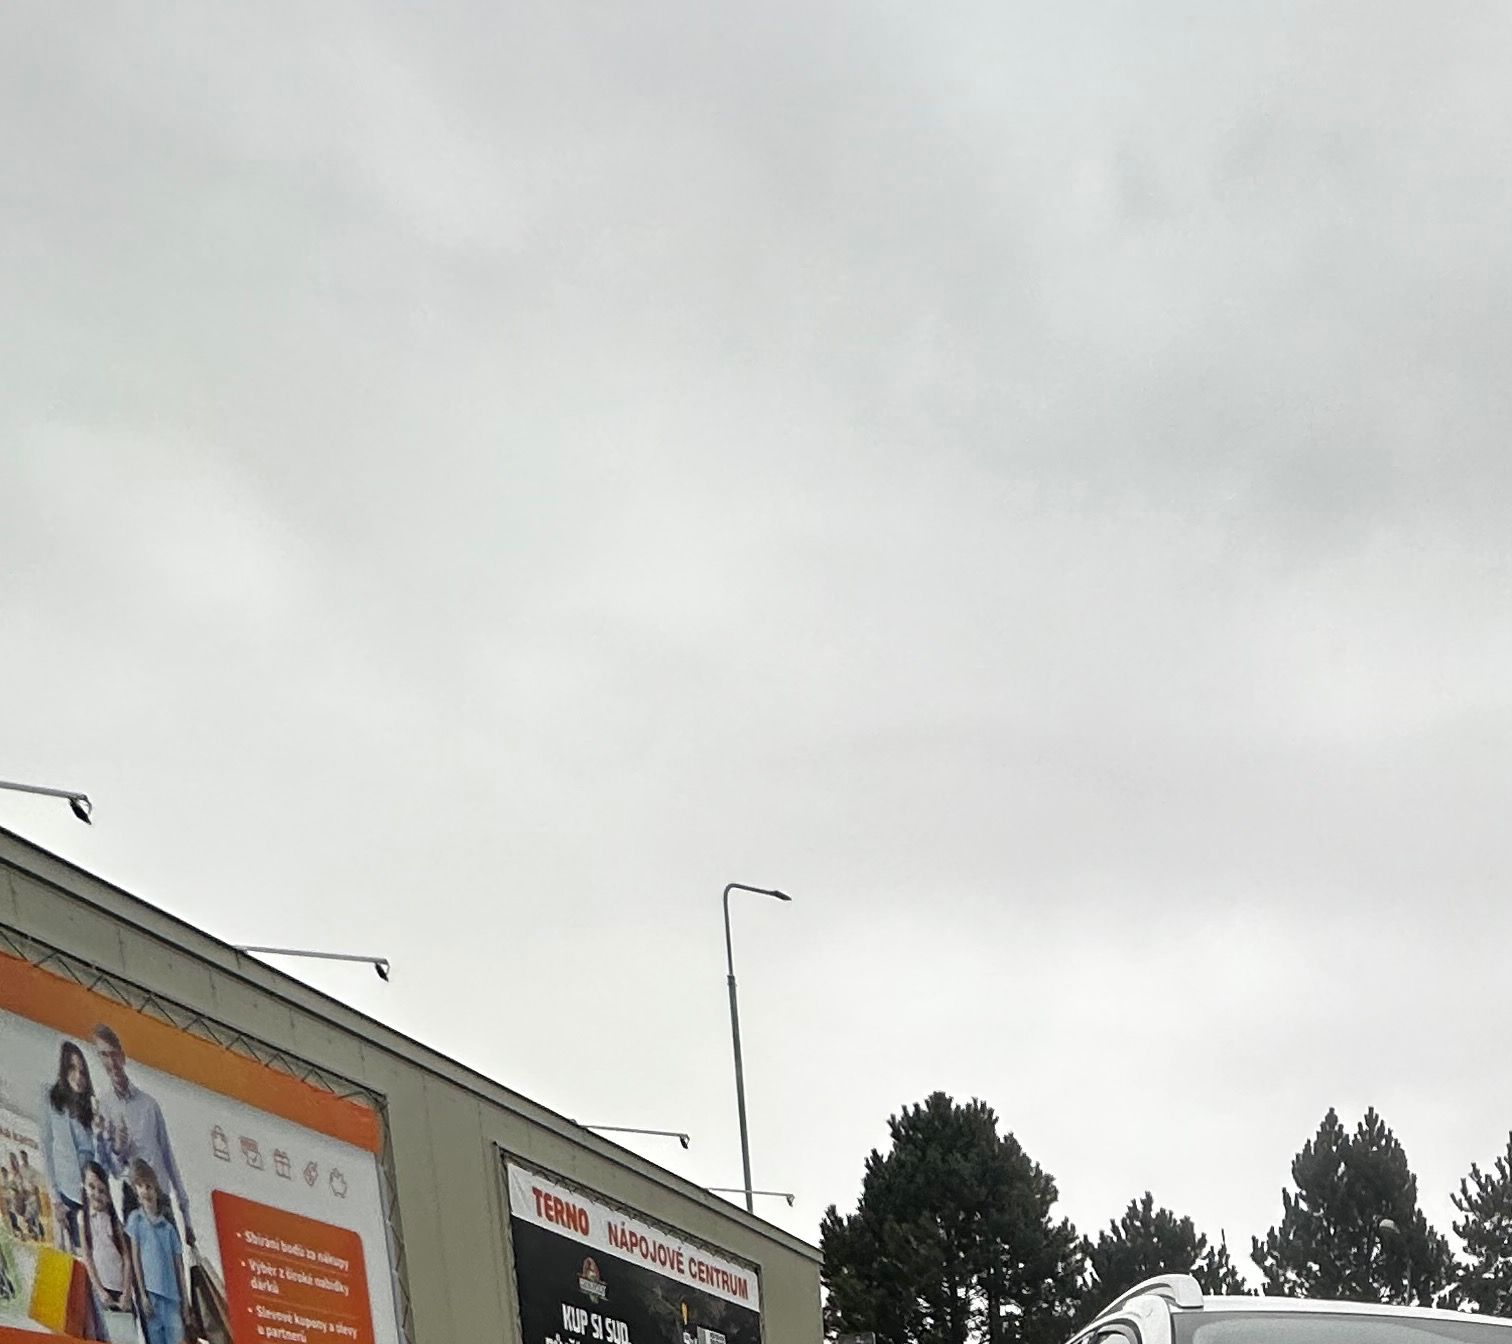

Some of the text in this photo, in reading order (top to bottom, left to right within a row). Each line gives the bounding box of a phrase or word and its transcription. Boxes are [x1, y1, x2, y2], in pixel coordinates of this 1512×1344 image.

[532, 1187, 749, 1300] TERNO NÁPOJOVÉ CENTRUM
[562, 1303, 588, 1335] KUP
[591, 1313, 603, 1340] SI
